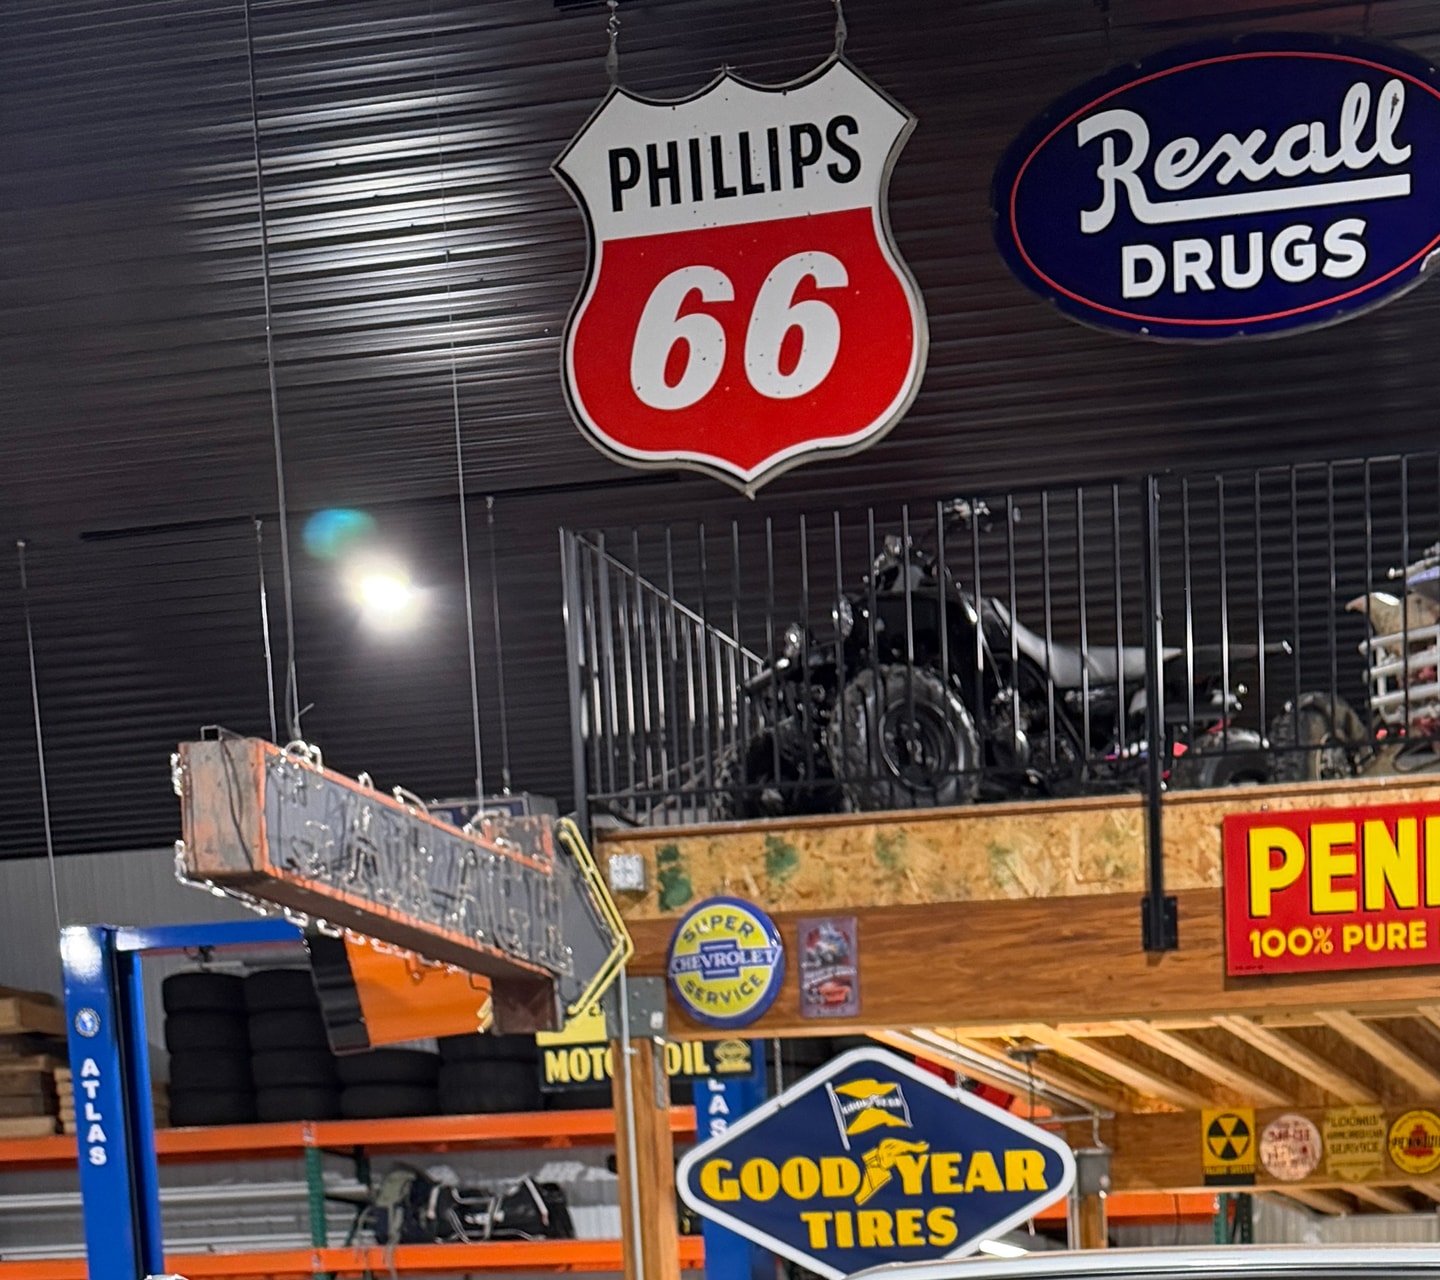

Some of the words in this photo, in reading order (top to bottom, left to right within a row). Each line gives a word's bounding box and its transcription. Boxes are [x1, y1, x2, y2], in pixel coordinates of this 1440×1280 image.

[609, 115, 861, 212] PHILLIPS
[1078, 78, 1412, 234] Rexall
[1121, 218, 1367, 299] DRUGS
[630, 250, 849, 410] 66
[683, 915, 754, 943] SUPER
[1250, 923, 1334, 958] 100%
[1342, 918, 1427, 953] PURE
[672, 950, 775, 972] CHEVROLET
[684, 974, 764, 1005] SERVICE
[545, 1047, 614, 1084] MOT
[665, 1041, 710, 1076] OIL
[80, 1058, 107, 1166] ATLAS
[700, 1156, 862, 1202] GOOD
[895, 1149, 1048, 1195] YEAR
[800, 1207, 958, 1250] TIRES
